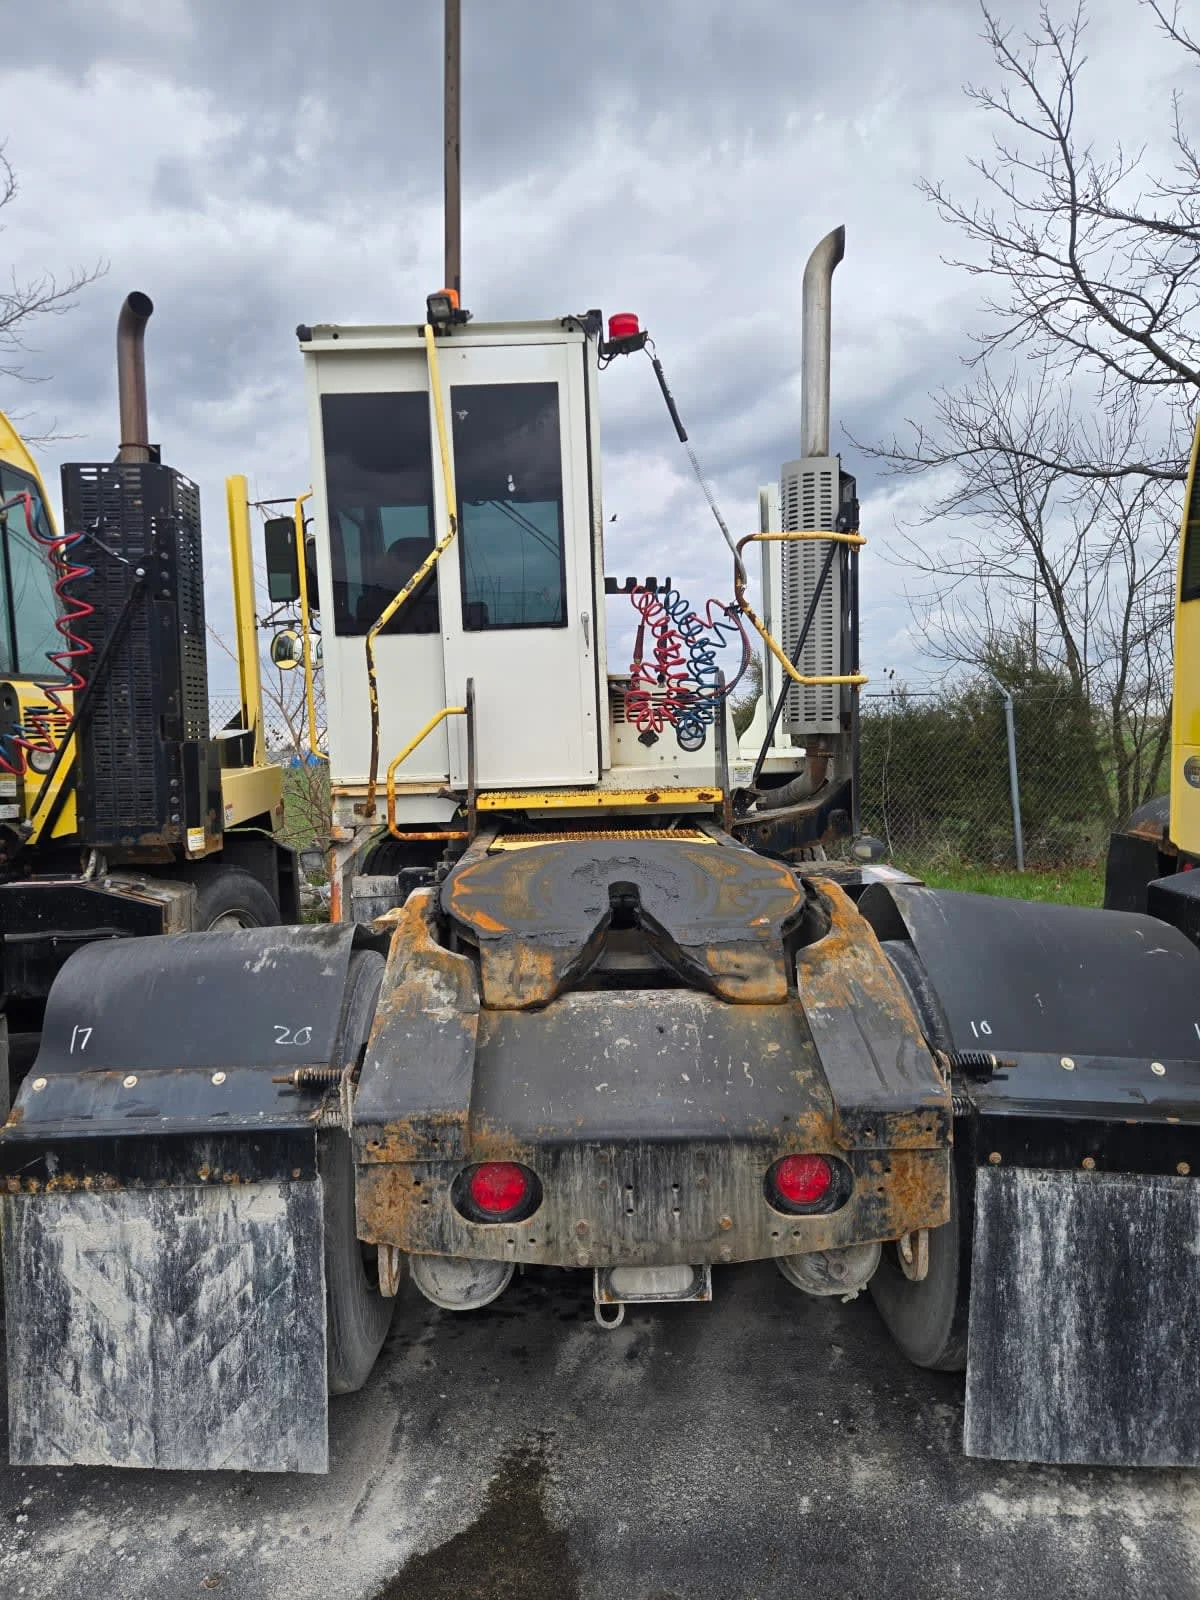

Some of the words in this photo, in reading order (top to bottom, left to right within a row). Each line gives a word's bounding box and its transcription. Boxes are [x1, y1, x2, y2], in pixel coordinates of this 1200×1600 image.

[70, 1025, 93, 1054] 17
[273, 1025, 313, 1046] 20
[970, 1020, 993, 1038] 10
